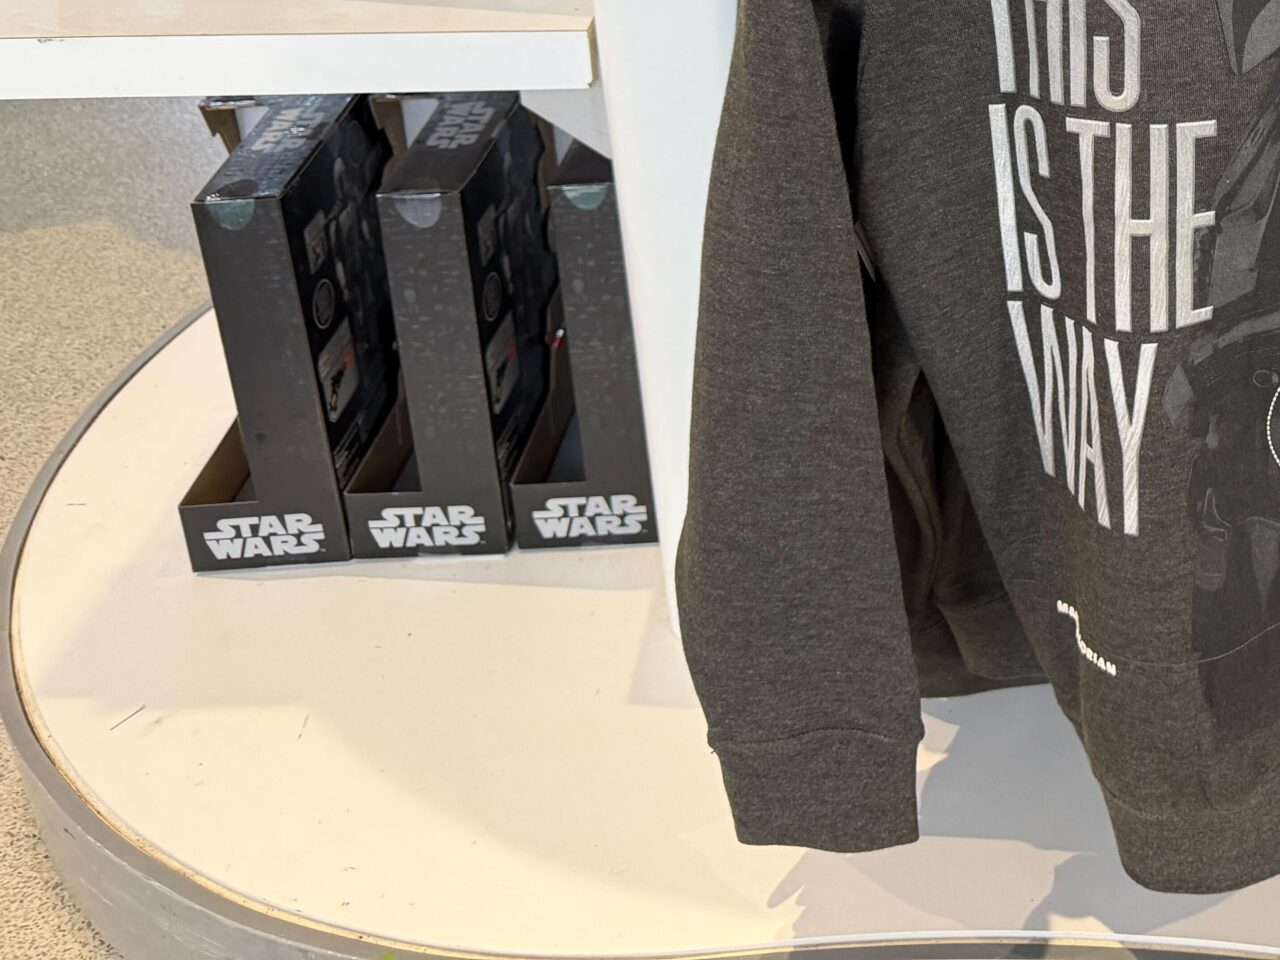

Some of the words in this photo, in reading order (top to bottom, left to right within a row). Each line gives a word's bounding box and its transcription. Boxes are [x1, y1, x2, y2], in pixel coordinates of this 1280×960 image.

[987, 102, 1062, 301] IS
[1065, 116, 1218, 334] THE
[1006, 300, 1159, 537] WAY
[367, 504, 486, 534] STAR
[532, 493, 648, 522] STAR
[203, 512, 326, 542] STAR
[370, 523, 486, 549] WARS
[534, 512, 648, 539] WARS
[205, 533, 326, 560] WARS
